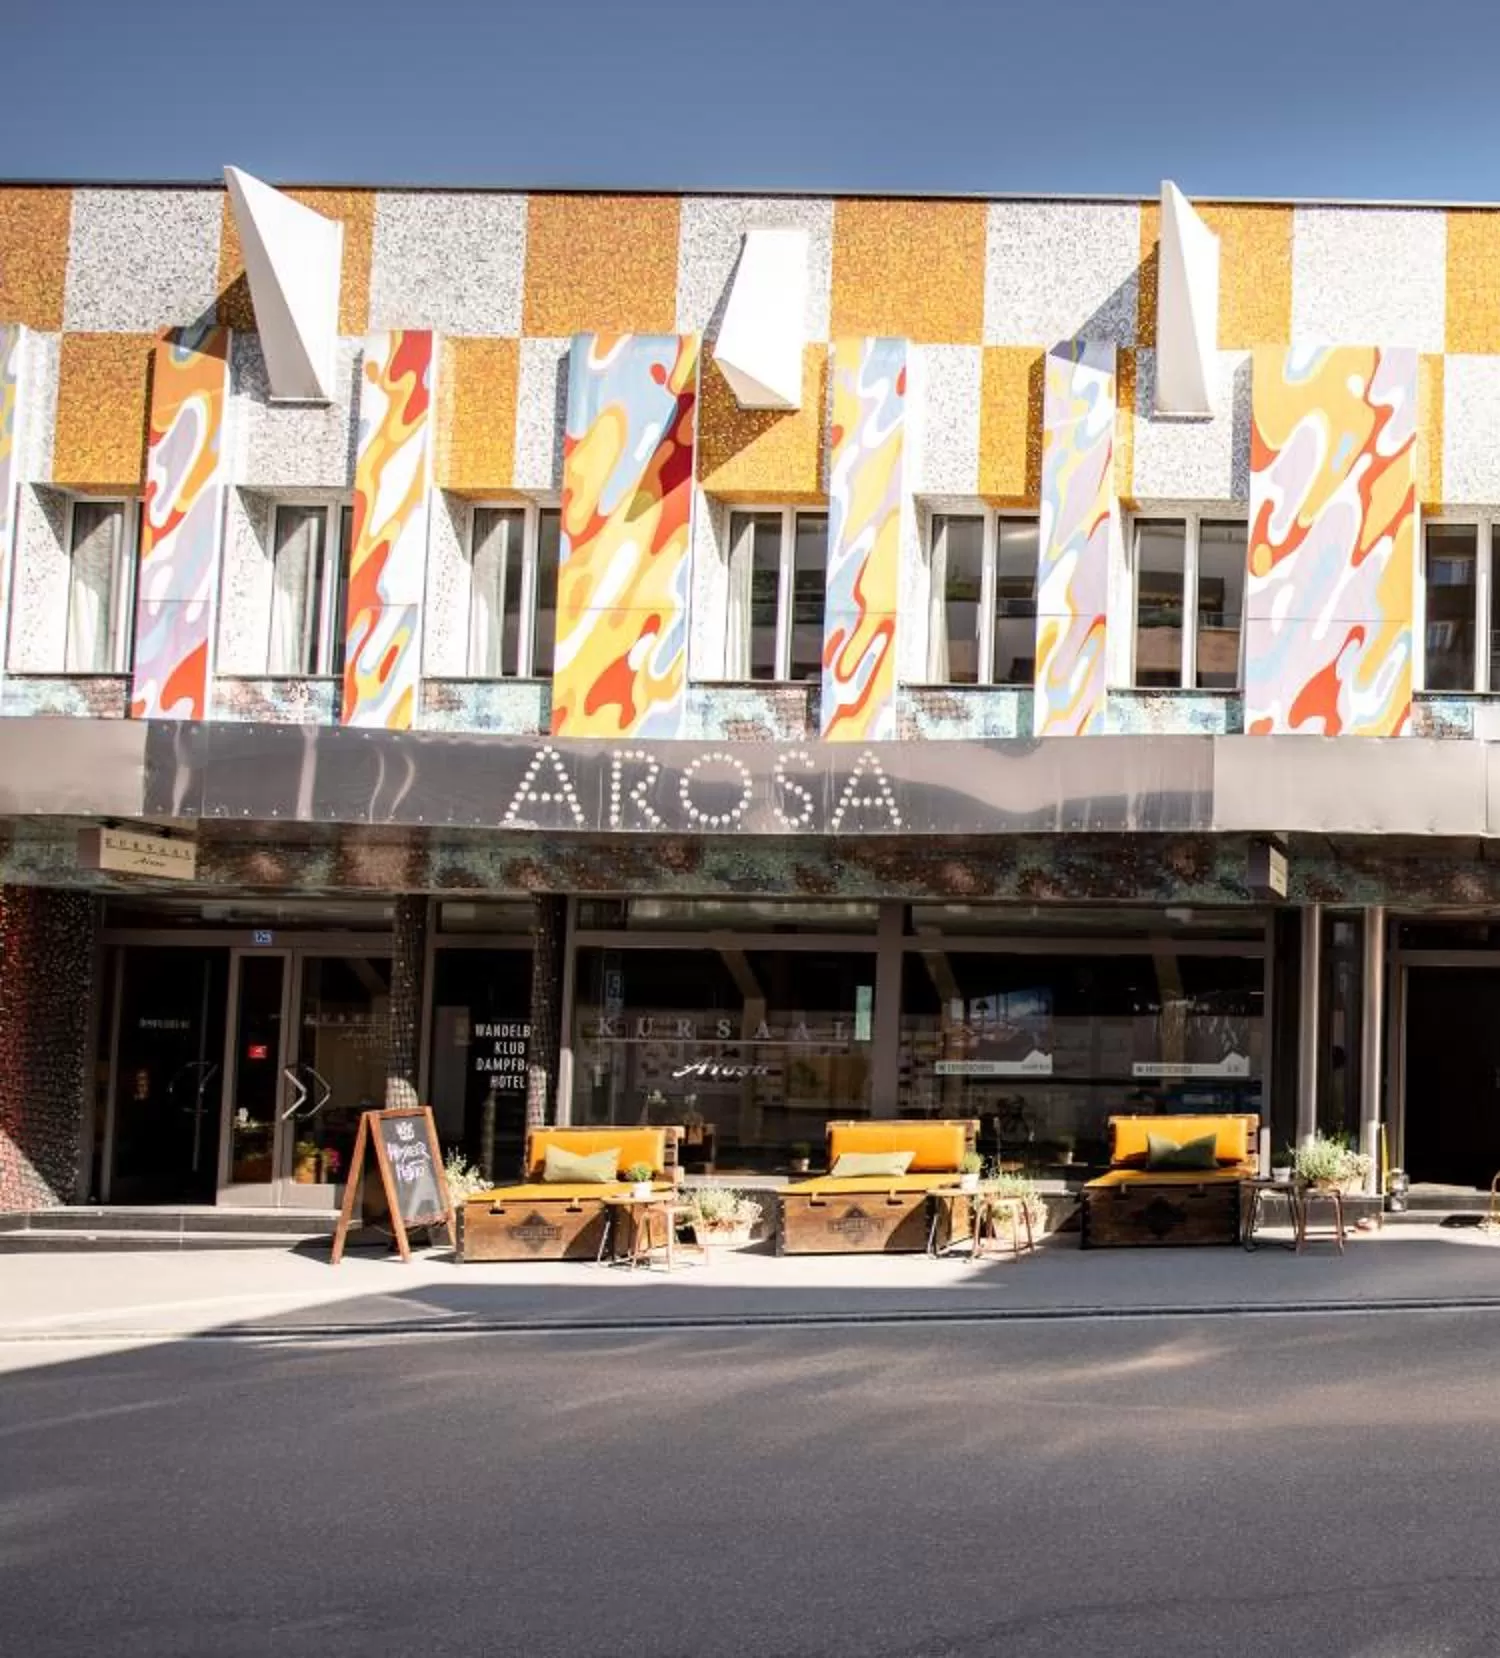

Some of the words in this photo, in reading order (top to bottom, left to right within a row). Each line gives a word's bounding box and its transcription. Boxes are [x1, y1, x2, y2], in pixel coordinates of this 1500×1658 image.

[502, 744, 902, 826] AROSA
[475, 1023, 531, 1037] WANDELB
[598, 1016, 849, 1041] KURSAAL
[494, 1041, 525, 1055] KLUB
[476, 1057, 530, 1072] DAMPFB
[490, 1075, 526, 1089] HOTEL
